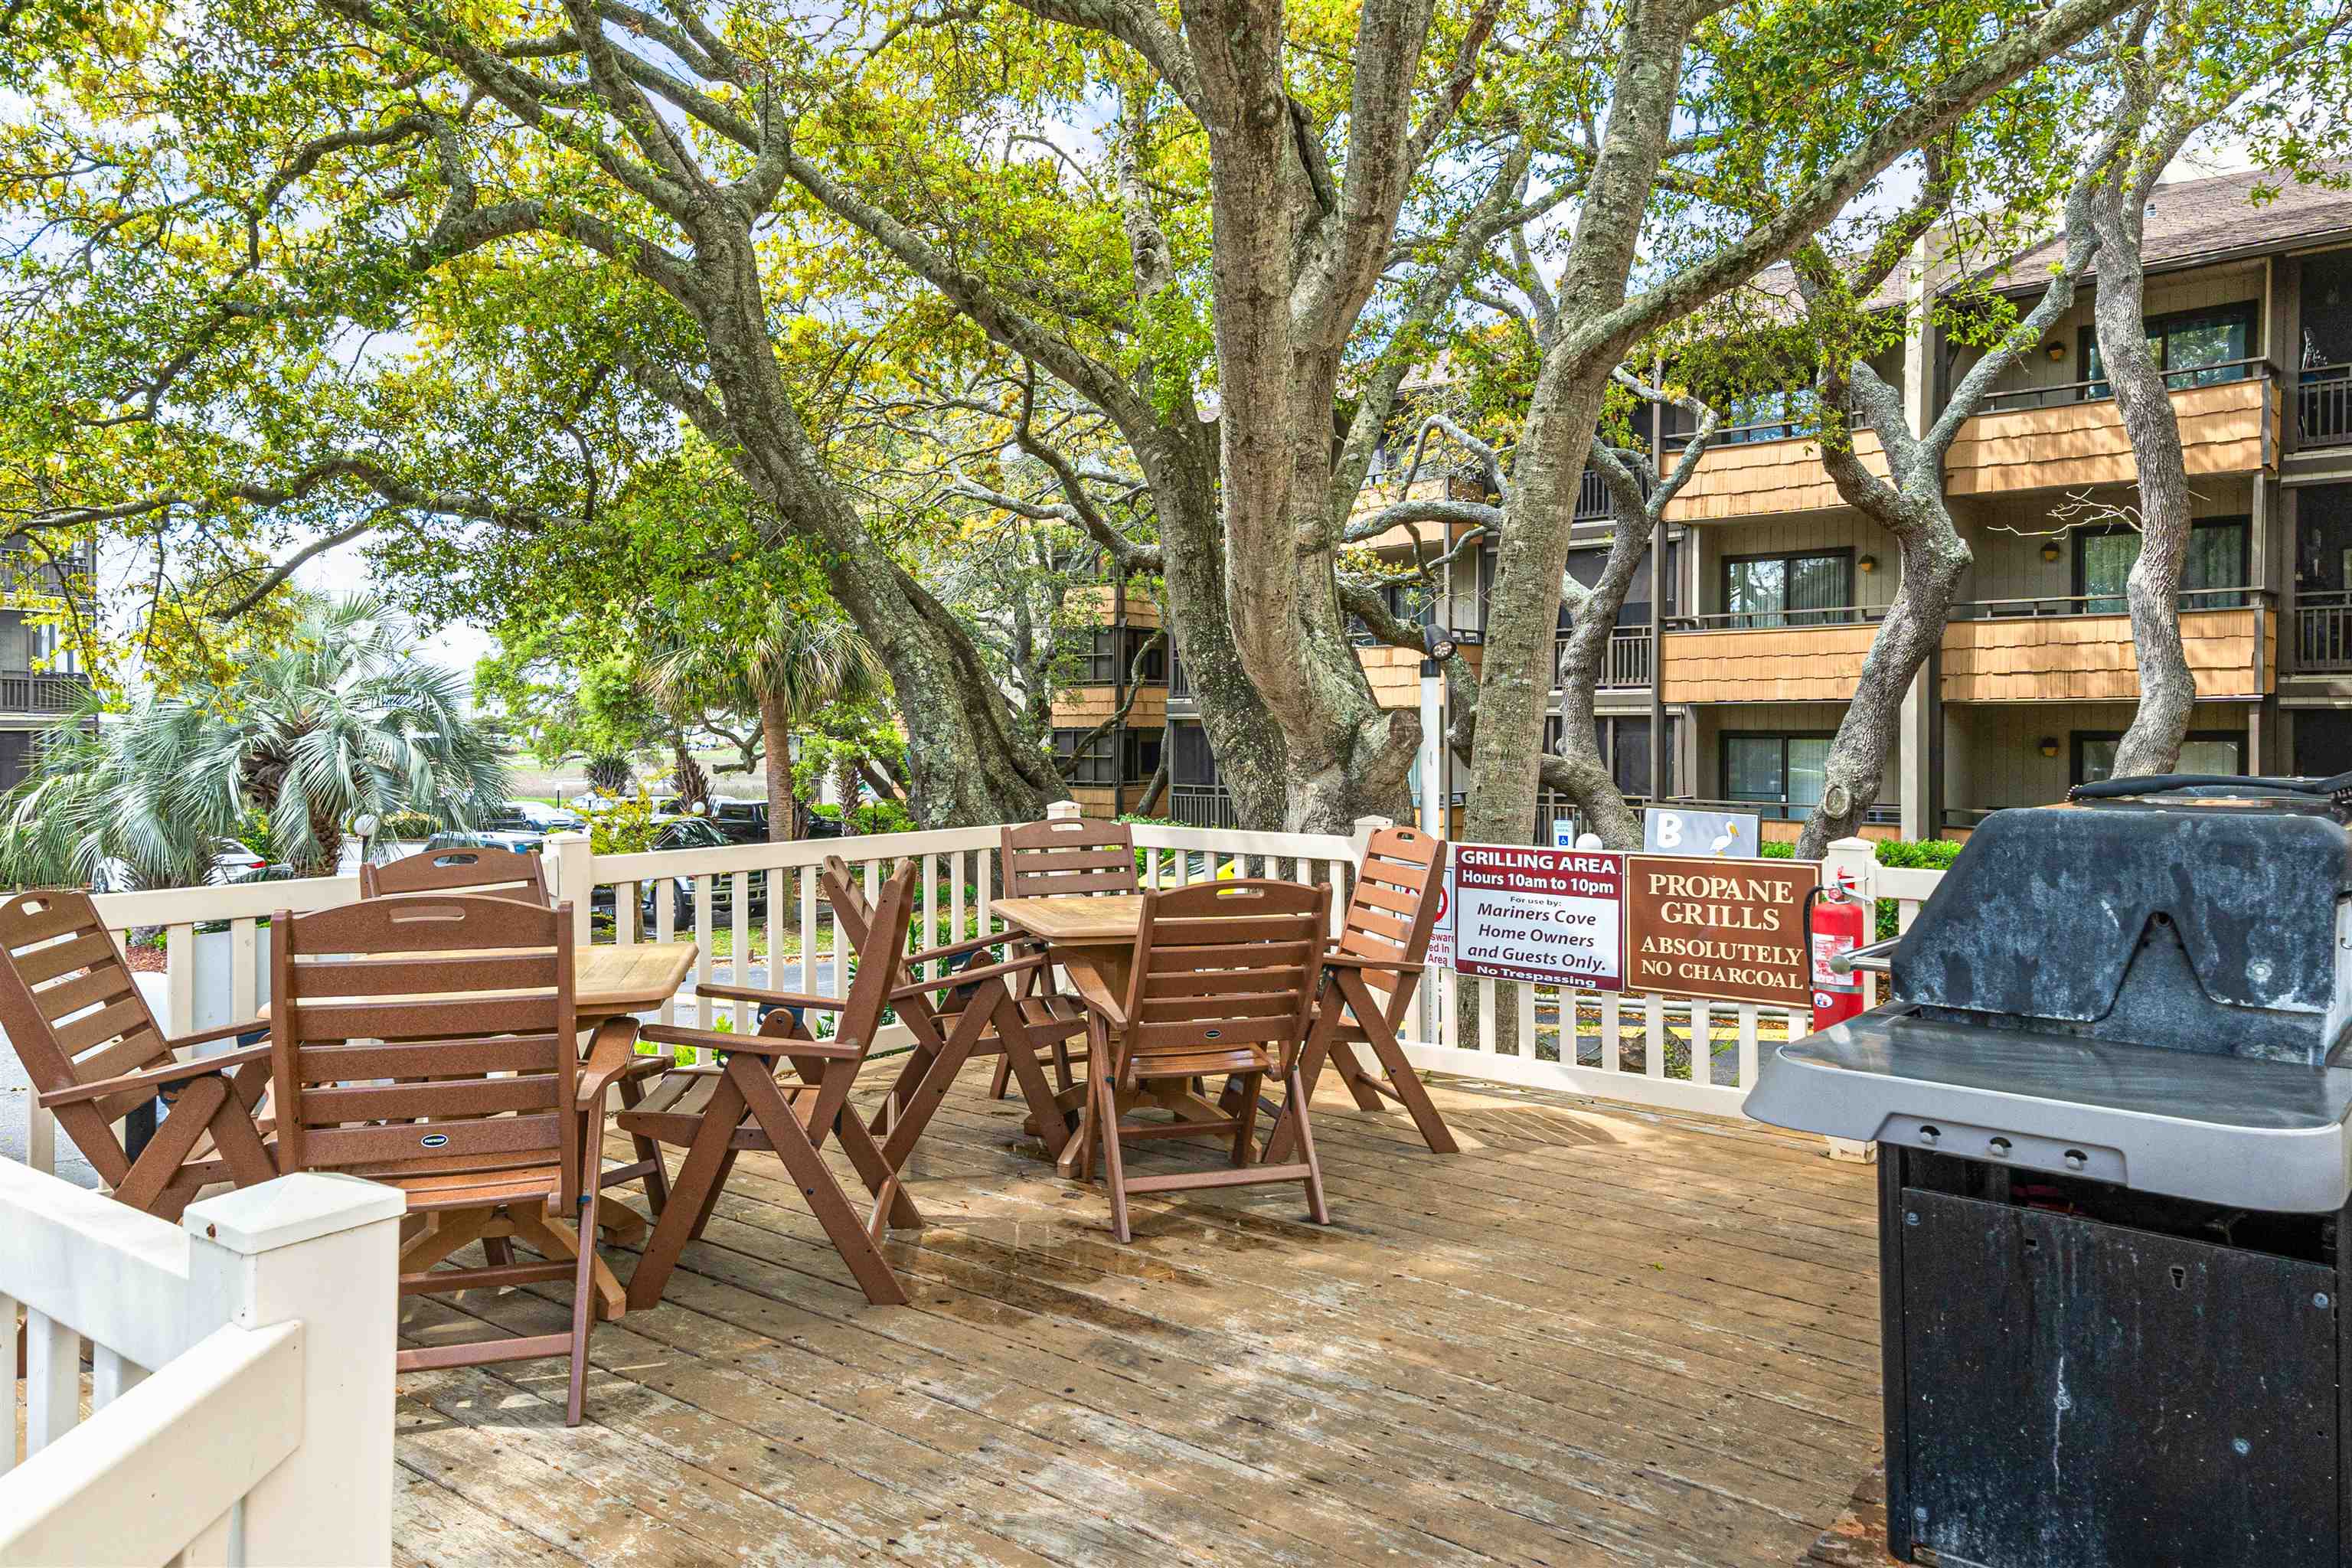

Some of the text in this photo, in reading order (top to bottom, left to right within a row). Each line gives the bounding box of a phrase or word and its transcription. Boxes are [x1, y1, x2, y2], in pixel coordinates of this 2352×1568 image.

[1657, 812, 1683, 848] B
[1461, 850, 1616, 874] GRILLING AREA
[1462, 869, 1614, 895] Hours 10am to 10pm
[1648, 874, 1794, 904] PROPANE
[1477, 903, 1596, 926] Mariners Cove
[1661, 901, 1780, 932] GRILLS
[1478, 923, 1594, 947] Home Owners
[1428, 953, 1448, 965] Area
[1468, 946, 1606, 973] and Guests Only.
[1640, 936, 1804, 966] ABSOLUTELY
[1476, 965, 1596, 988] No Trespassing
[1641, 959, 1804, 990] NO CHARCOAL
